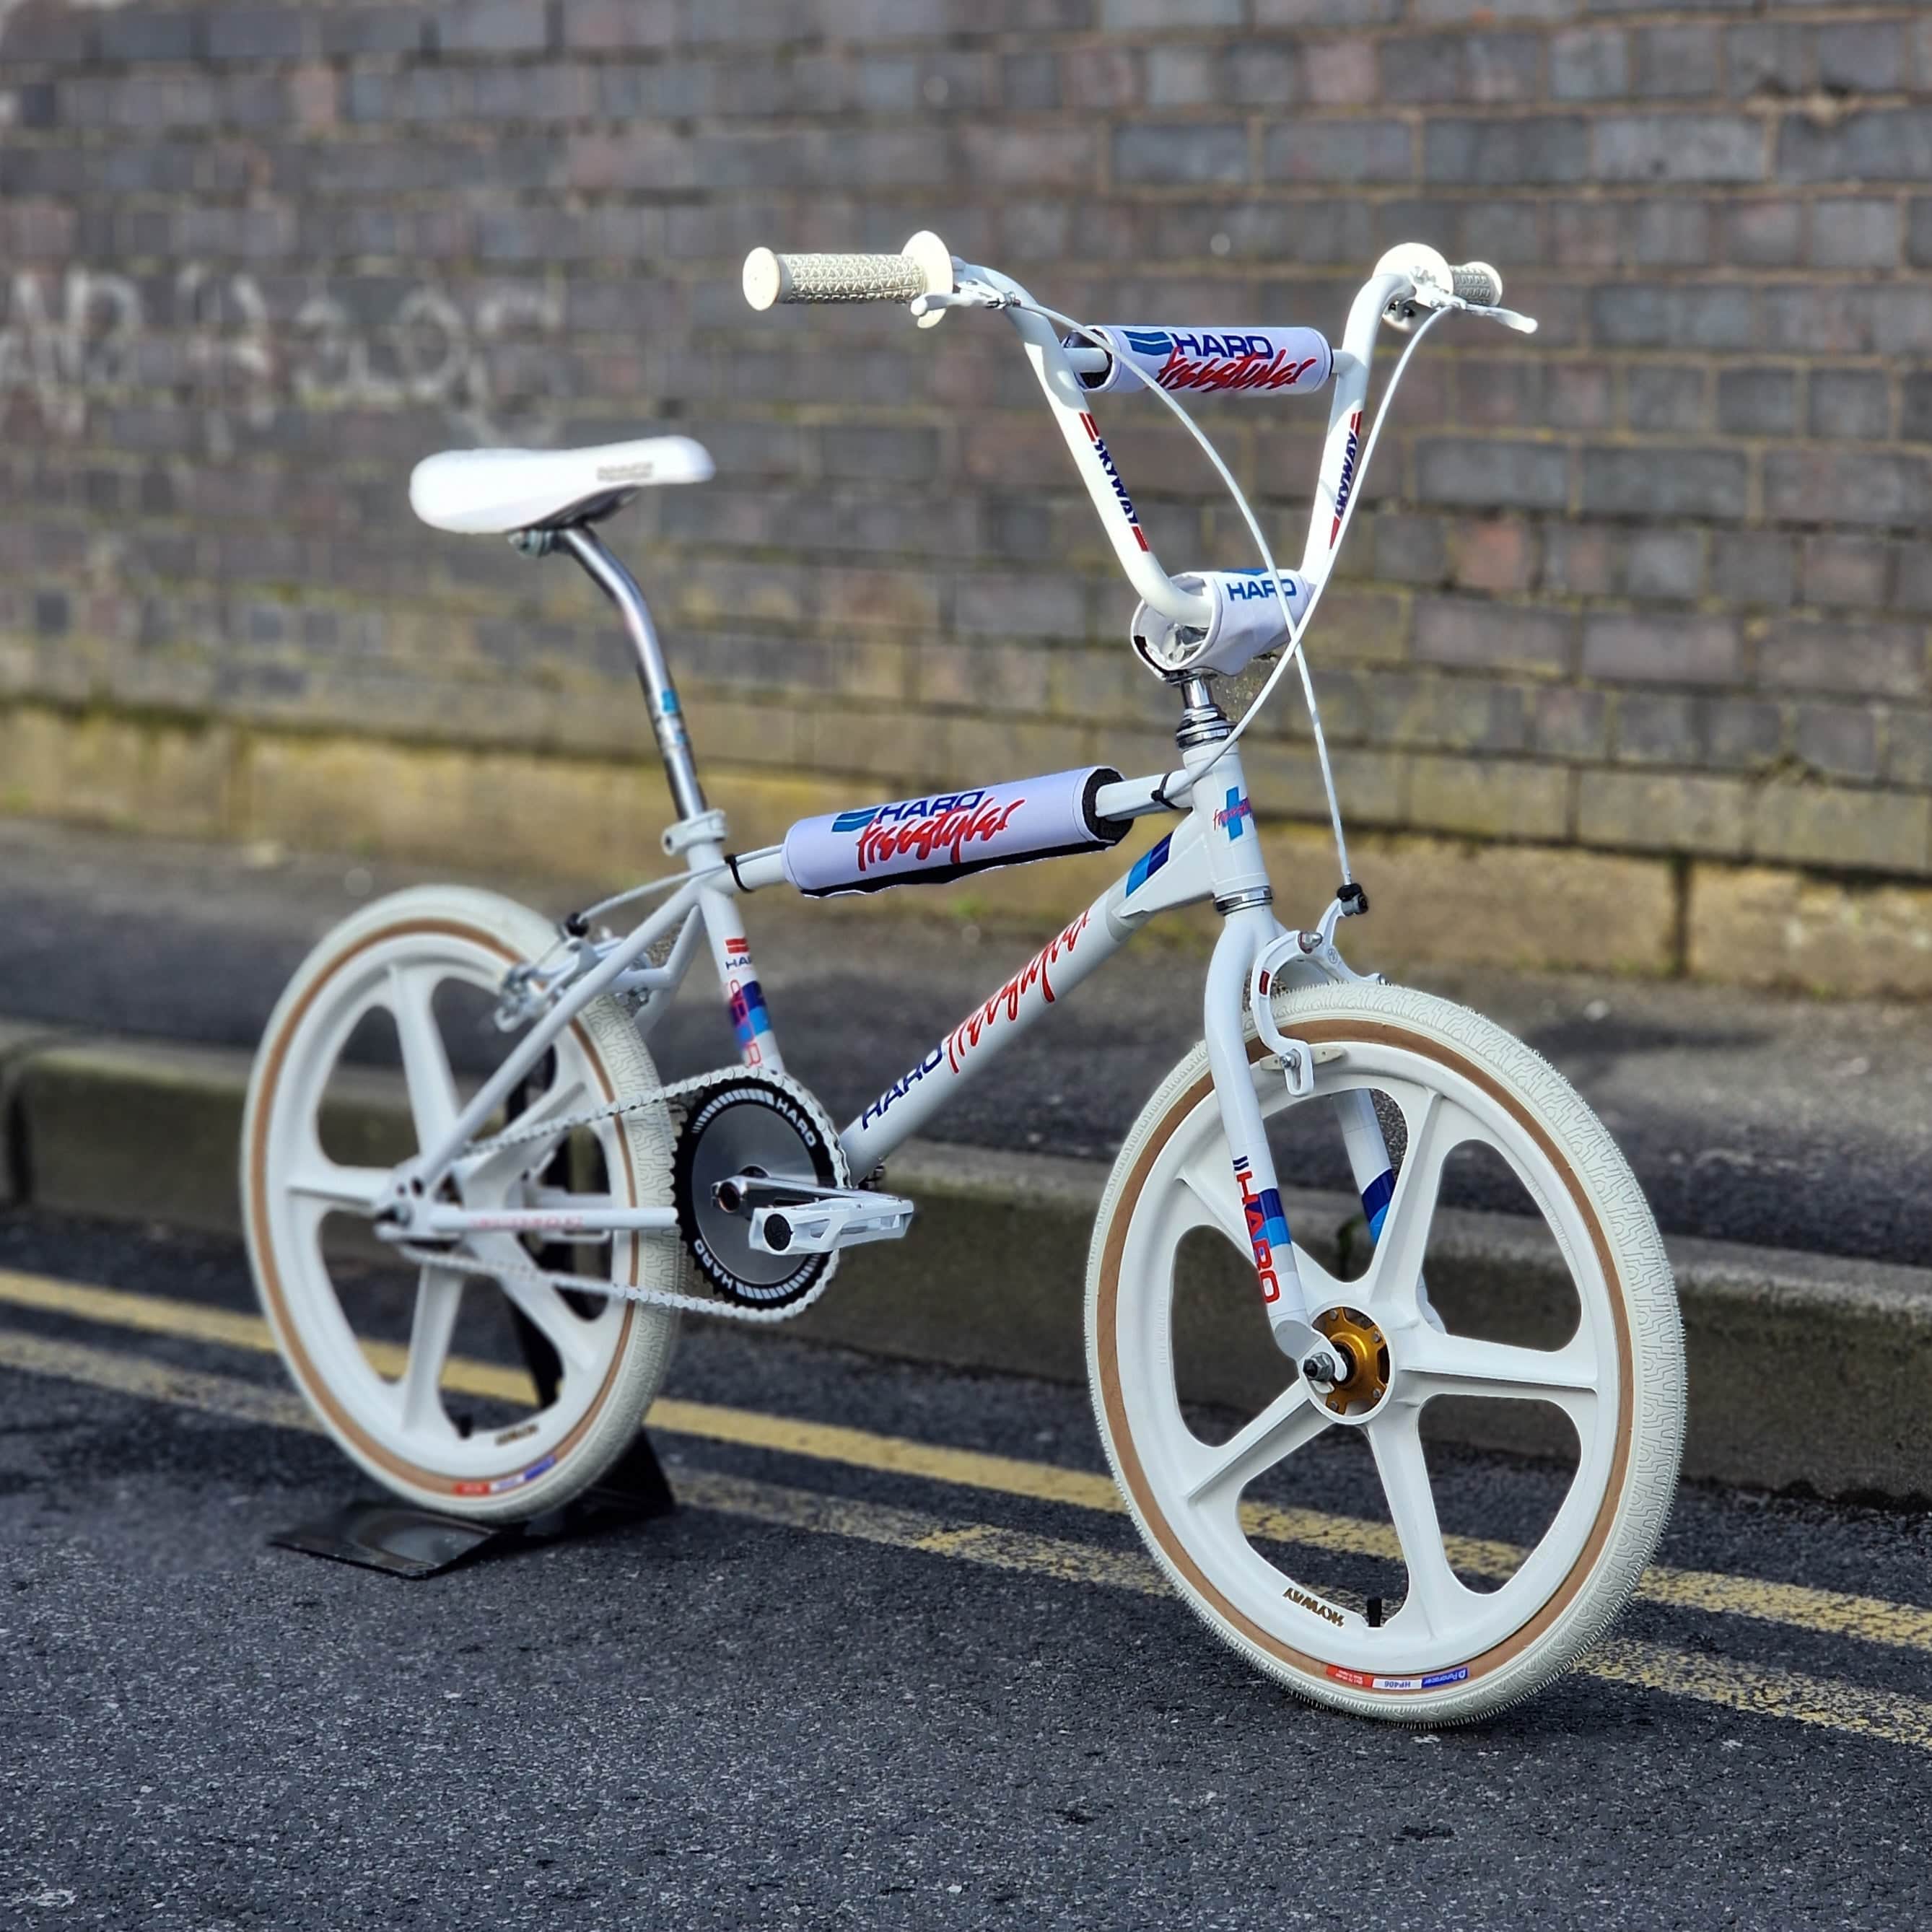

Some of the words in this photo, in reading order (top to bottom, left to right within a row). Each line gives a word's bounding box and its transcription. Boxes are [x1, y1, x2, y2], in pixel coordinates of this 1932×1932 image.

[1169, 333, 1273, 359] HARO
[877, 790, 985, 822] HARO
[776, 1098, 817, 1147] HARO
[1236, 1170, 1280, 1303] HARO
[694, 1239, 733, 1290] HARO
[1282, 1588, 1345, 1627] SKYWAY
